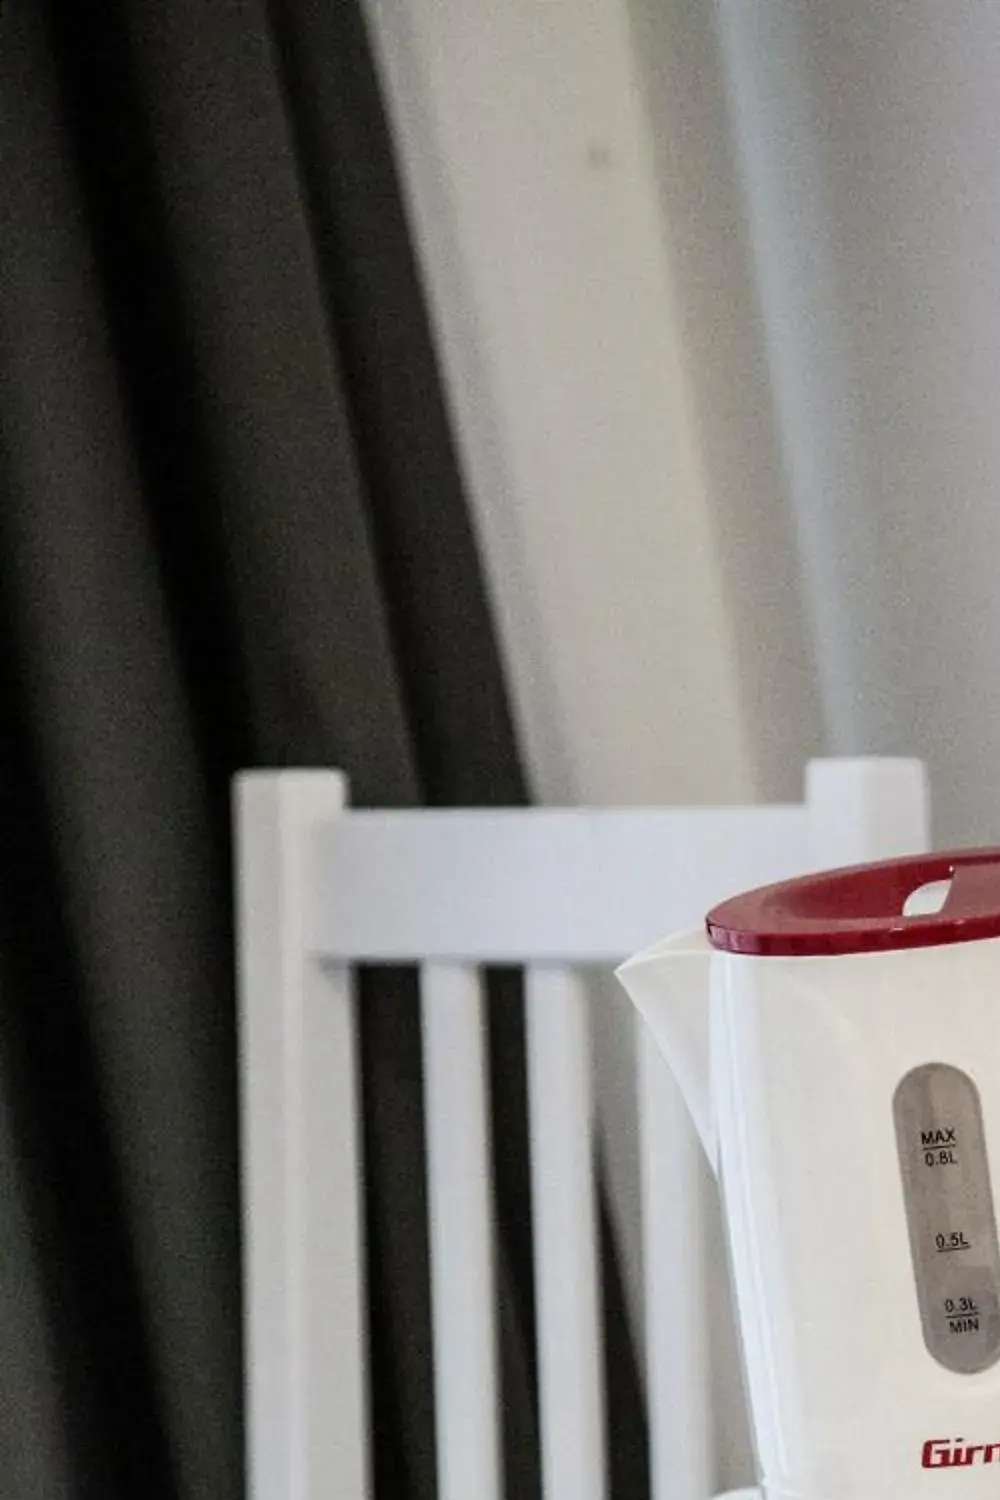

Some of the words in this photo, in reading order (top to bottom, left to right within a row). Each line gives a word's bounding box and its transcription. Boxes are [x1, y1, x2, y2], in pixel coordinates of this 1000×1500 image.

[921, 1128, 956, 1144] MAX
[925, 1151, 958, 1167] 0.8L
[935, 1231, 969, 1248] 0.5L
[944, 1297, 977, 1313] 0.3L
[949, 1318, 980, 1334] MIN
